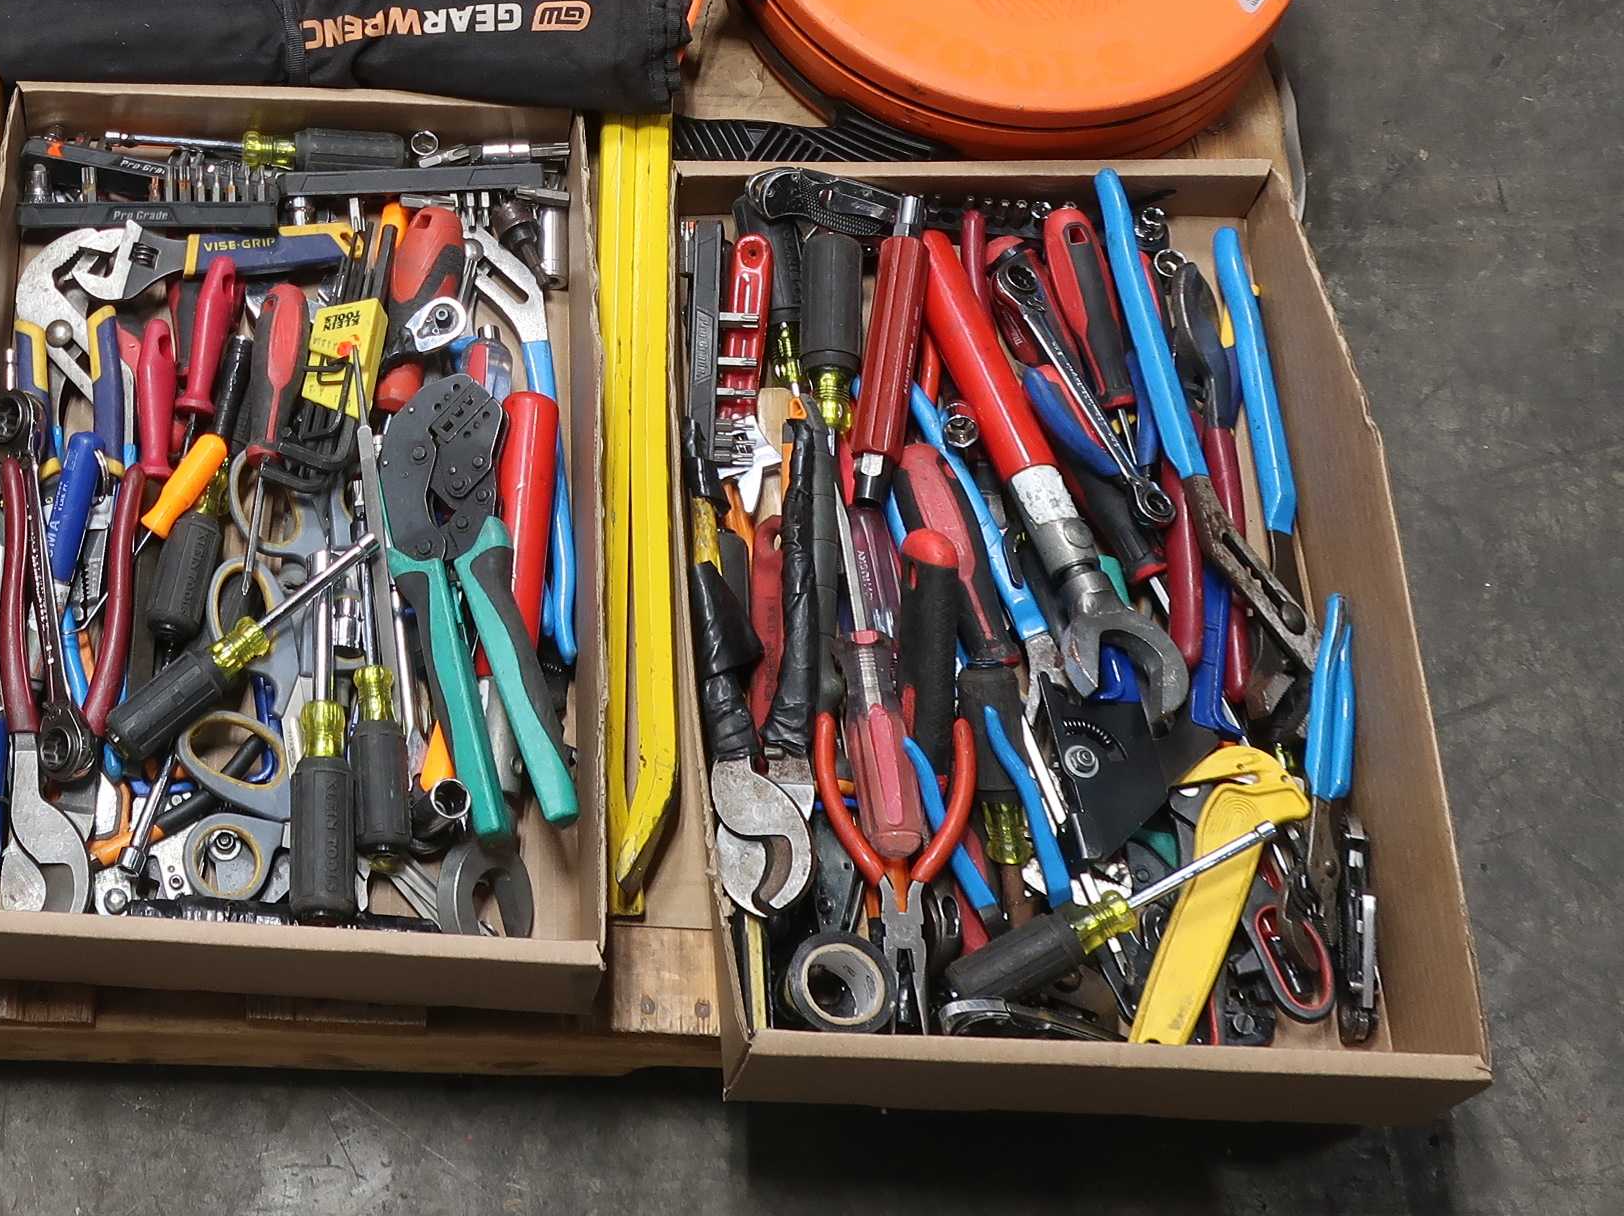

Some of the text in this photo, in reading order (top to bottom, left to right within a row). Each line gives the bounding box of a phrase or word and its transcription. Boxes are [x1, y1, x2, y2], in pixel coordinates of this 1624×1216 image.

[135, 210, 169, 221] Grade
[324, 310, 361, 324] TOOLS
[323, 318, 360, 332] KLEIN
